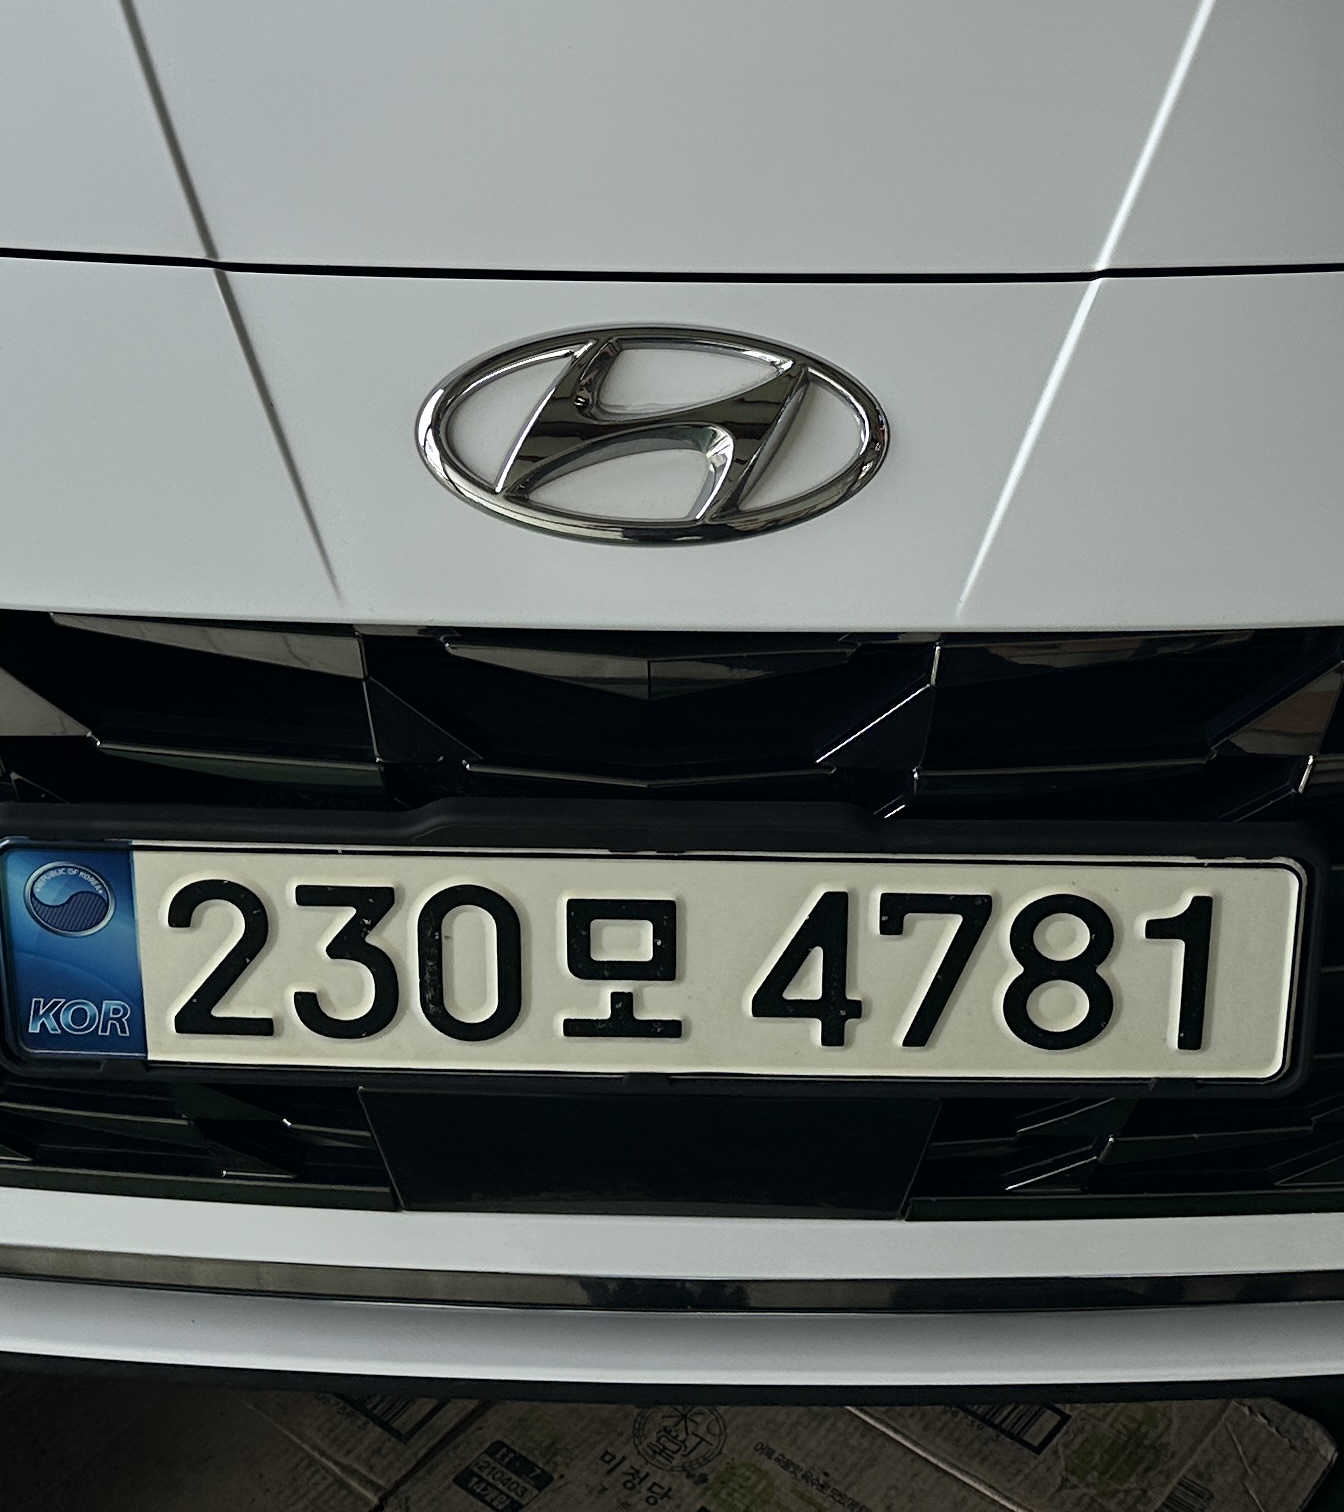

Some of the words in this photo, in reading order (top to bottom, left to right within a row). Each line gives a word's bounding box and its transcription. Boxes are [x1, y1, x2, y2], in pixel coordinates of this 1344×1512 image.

[166, 880, 684, 1041] 230모
[750, 890, 1217, 1051] 4781
[27, 997, 131, 1037] KOR
[477, 1460, 529, 1498] 210403
[599, 1449, 673, 1506] 미정당
